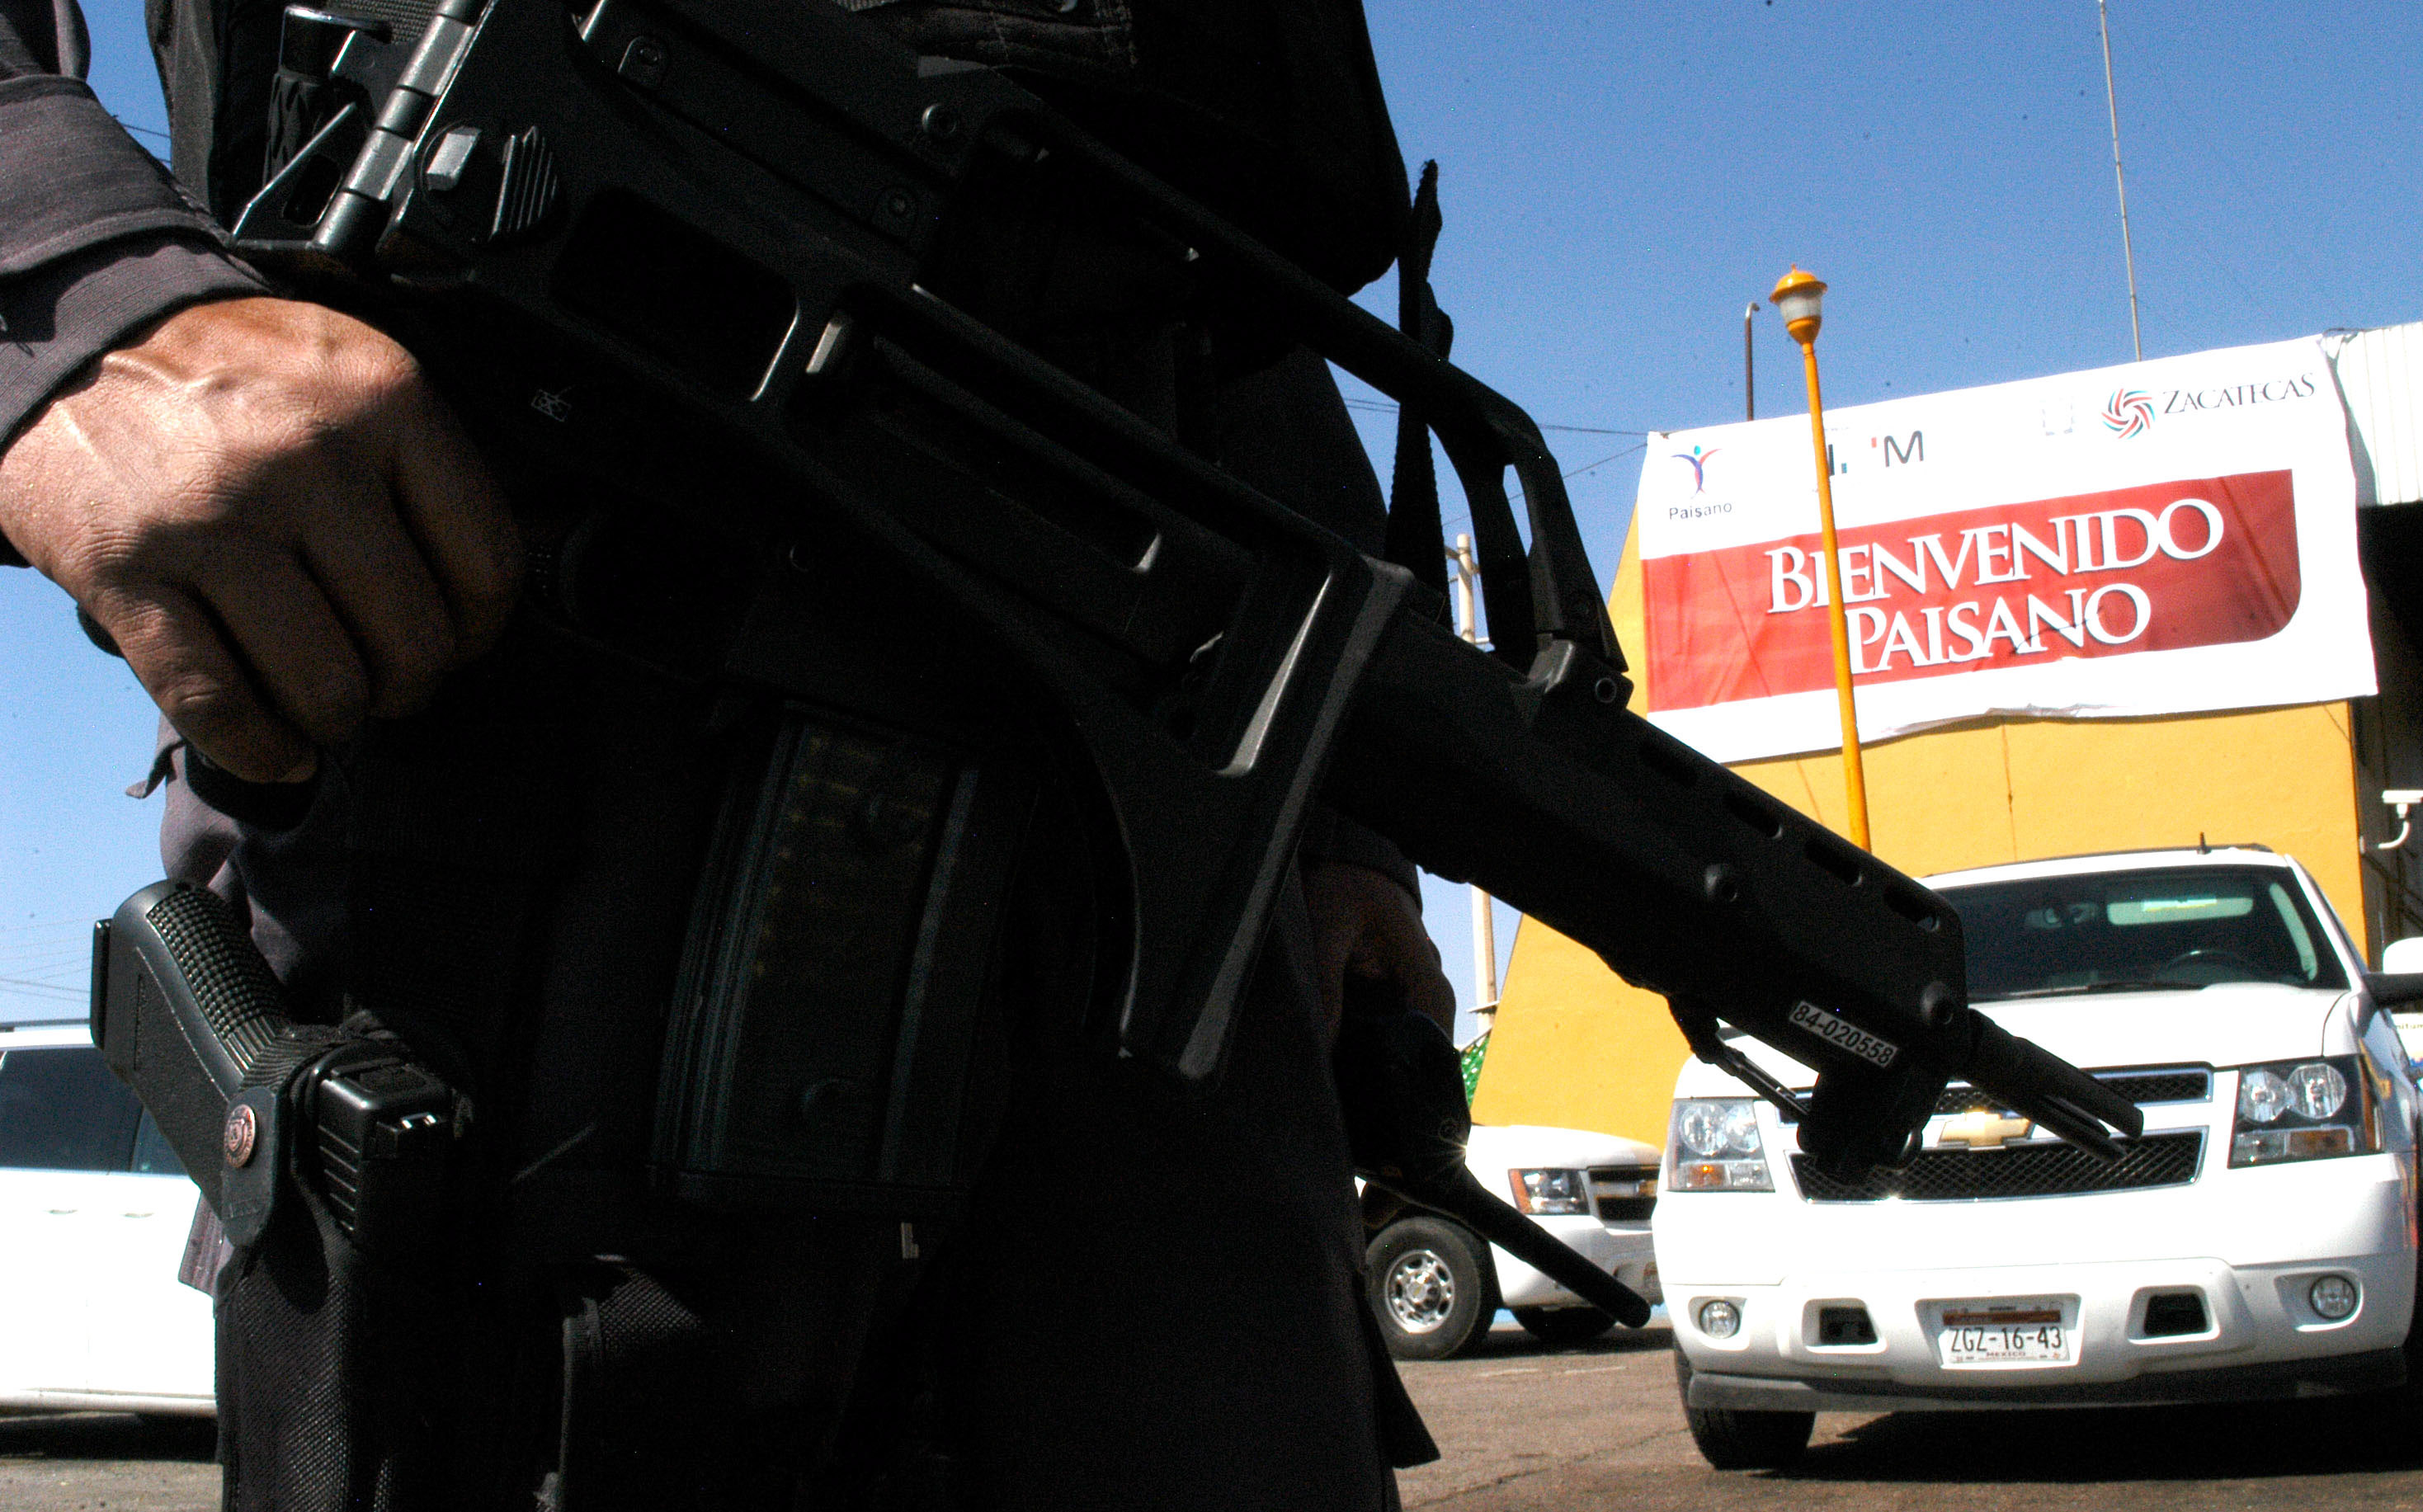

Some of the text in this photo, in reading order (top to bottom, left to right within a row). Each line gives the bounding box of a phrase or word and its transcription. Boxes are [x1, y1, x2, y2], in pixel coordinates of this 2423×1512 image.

[2161, 371, 2315, 414] ZACATECAS
[1668, 502, 1732, 520] Paisano
[1765, 497, 2224, 615] BIENVENIDO
[1844, 582, 2152, 676] PAISANO
[1793, 1004, 1894, 1064] 84-020558
[1950, 1326, 2062, 1353] ZGZ-16-43
